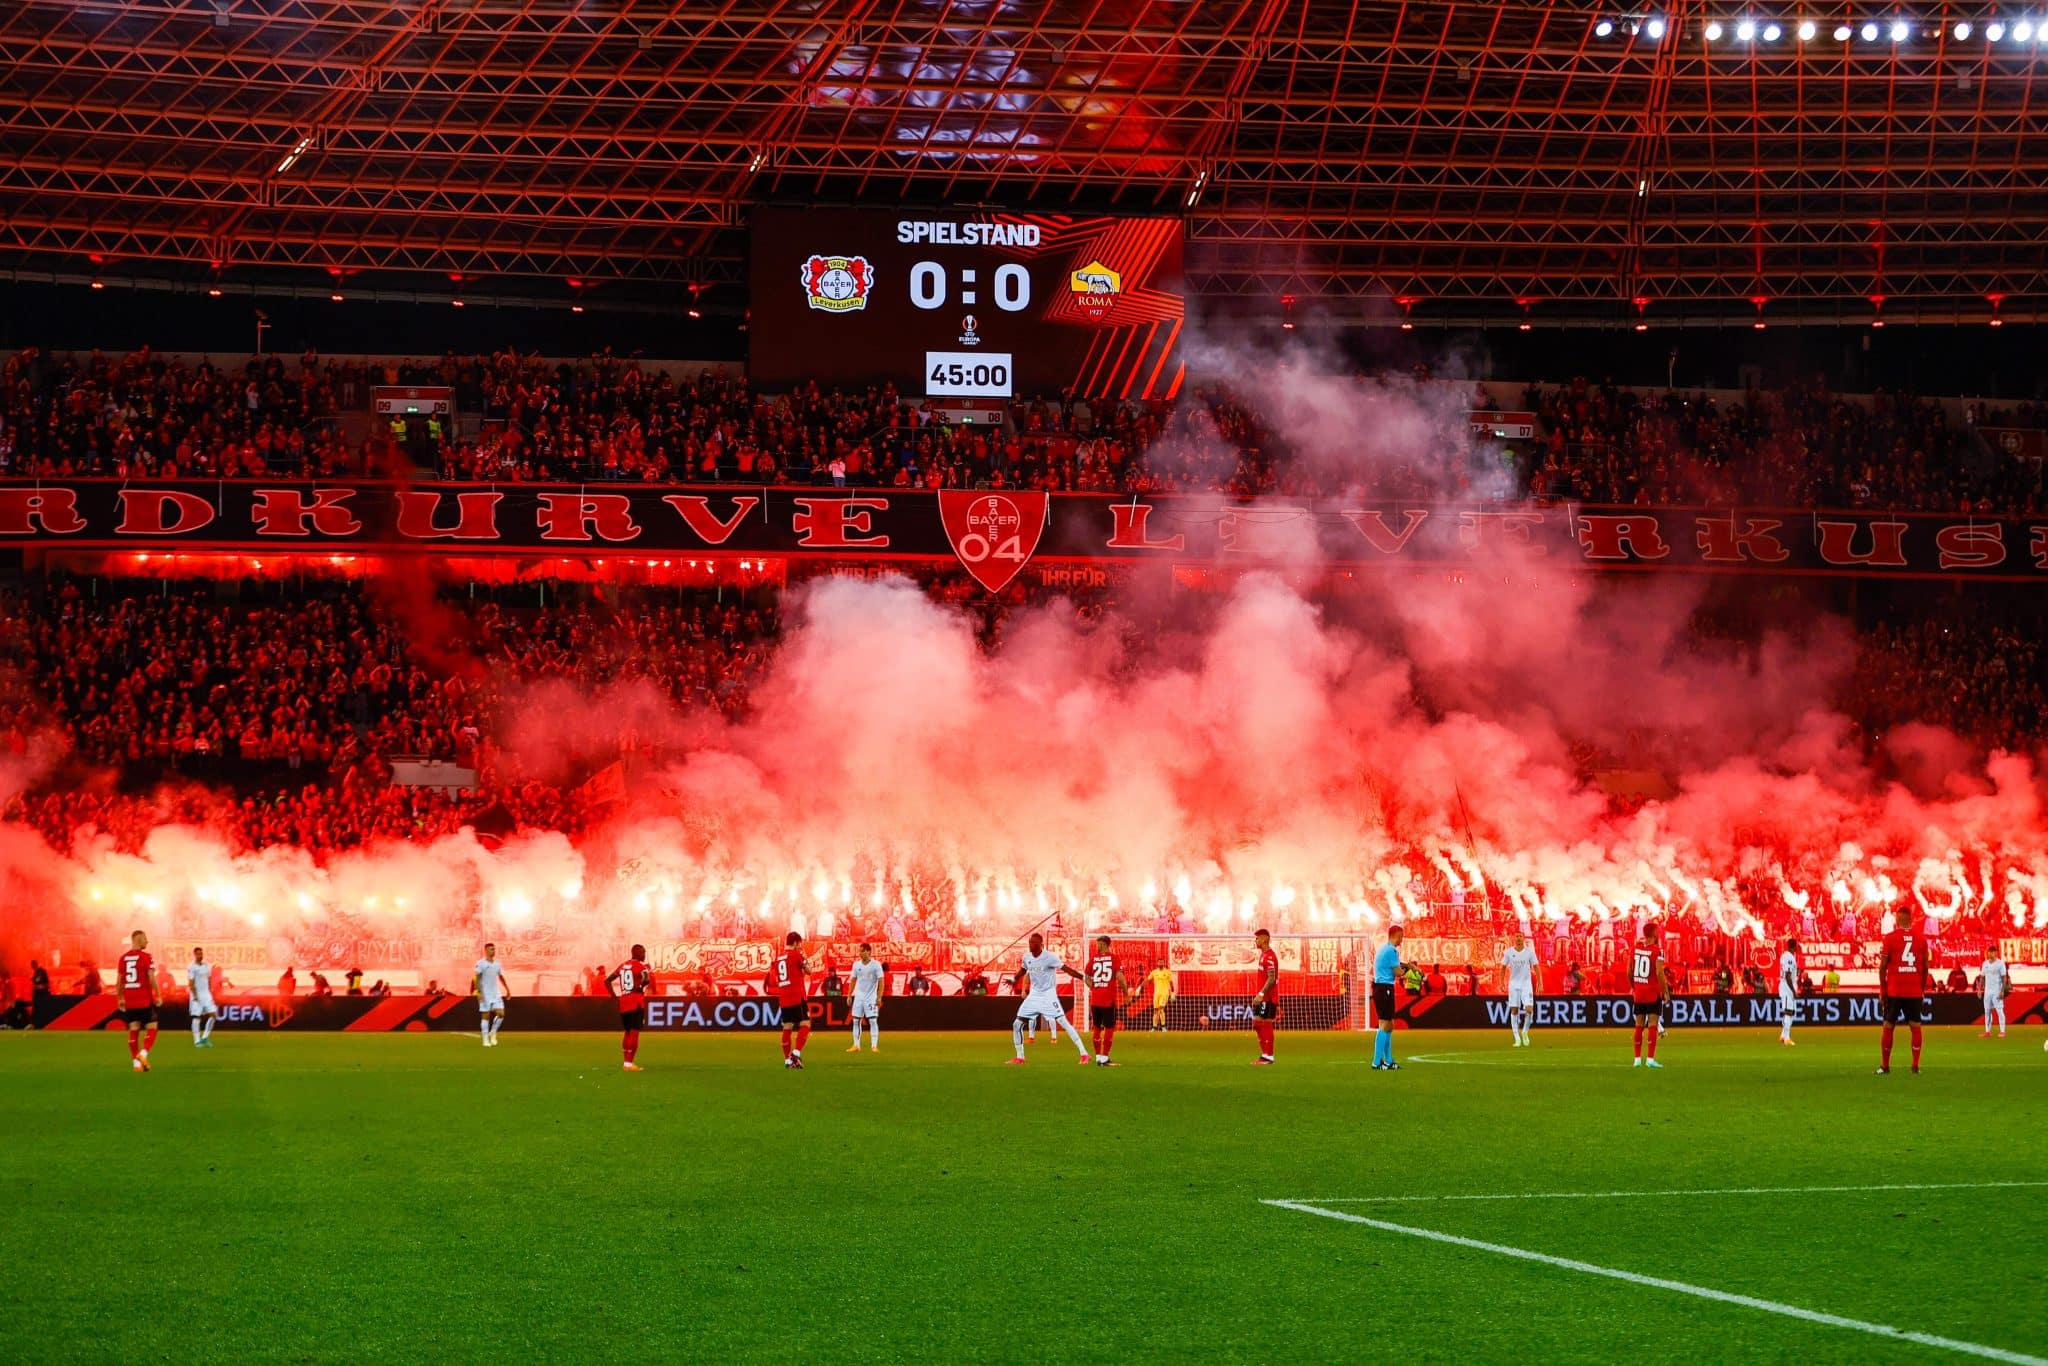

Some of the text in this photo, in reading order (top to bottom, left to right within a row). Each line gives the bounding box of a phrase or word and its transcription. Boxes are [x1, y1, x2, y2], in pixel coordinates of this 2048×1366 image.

[897, 221, 1041, 247] SPIELSTAND
[814, 297, 860, 308] Leverkusen
[1078, 296, 1112, 306] ROMA
[930, 364, 1007, 387] 45:00
[969, 515, 1018, 525] BAYER
[959, 533, 1025, 562] 04
[1310, 950, 1338, 961] SIDE
[1799, 943, 1851, 954] YOUNG
[1901, 942, 1916, 966] 4
[126, 961, 137, 982] 5
[778, 960, 787, 981] 9
[1093, 962, 1112, 982] 25
[1634, 954, 1650, 978] 10
[620, 969, 634, 990] 19
[648, 1002, 782, 1026] EFA.COM
[1208, 1005, 1254, 1020] UEFA
